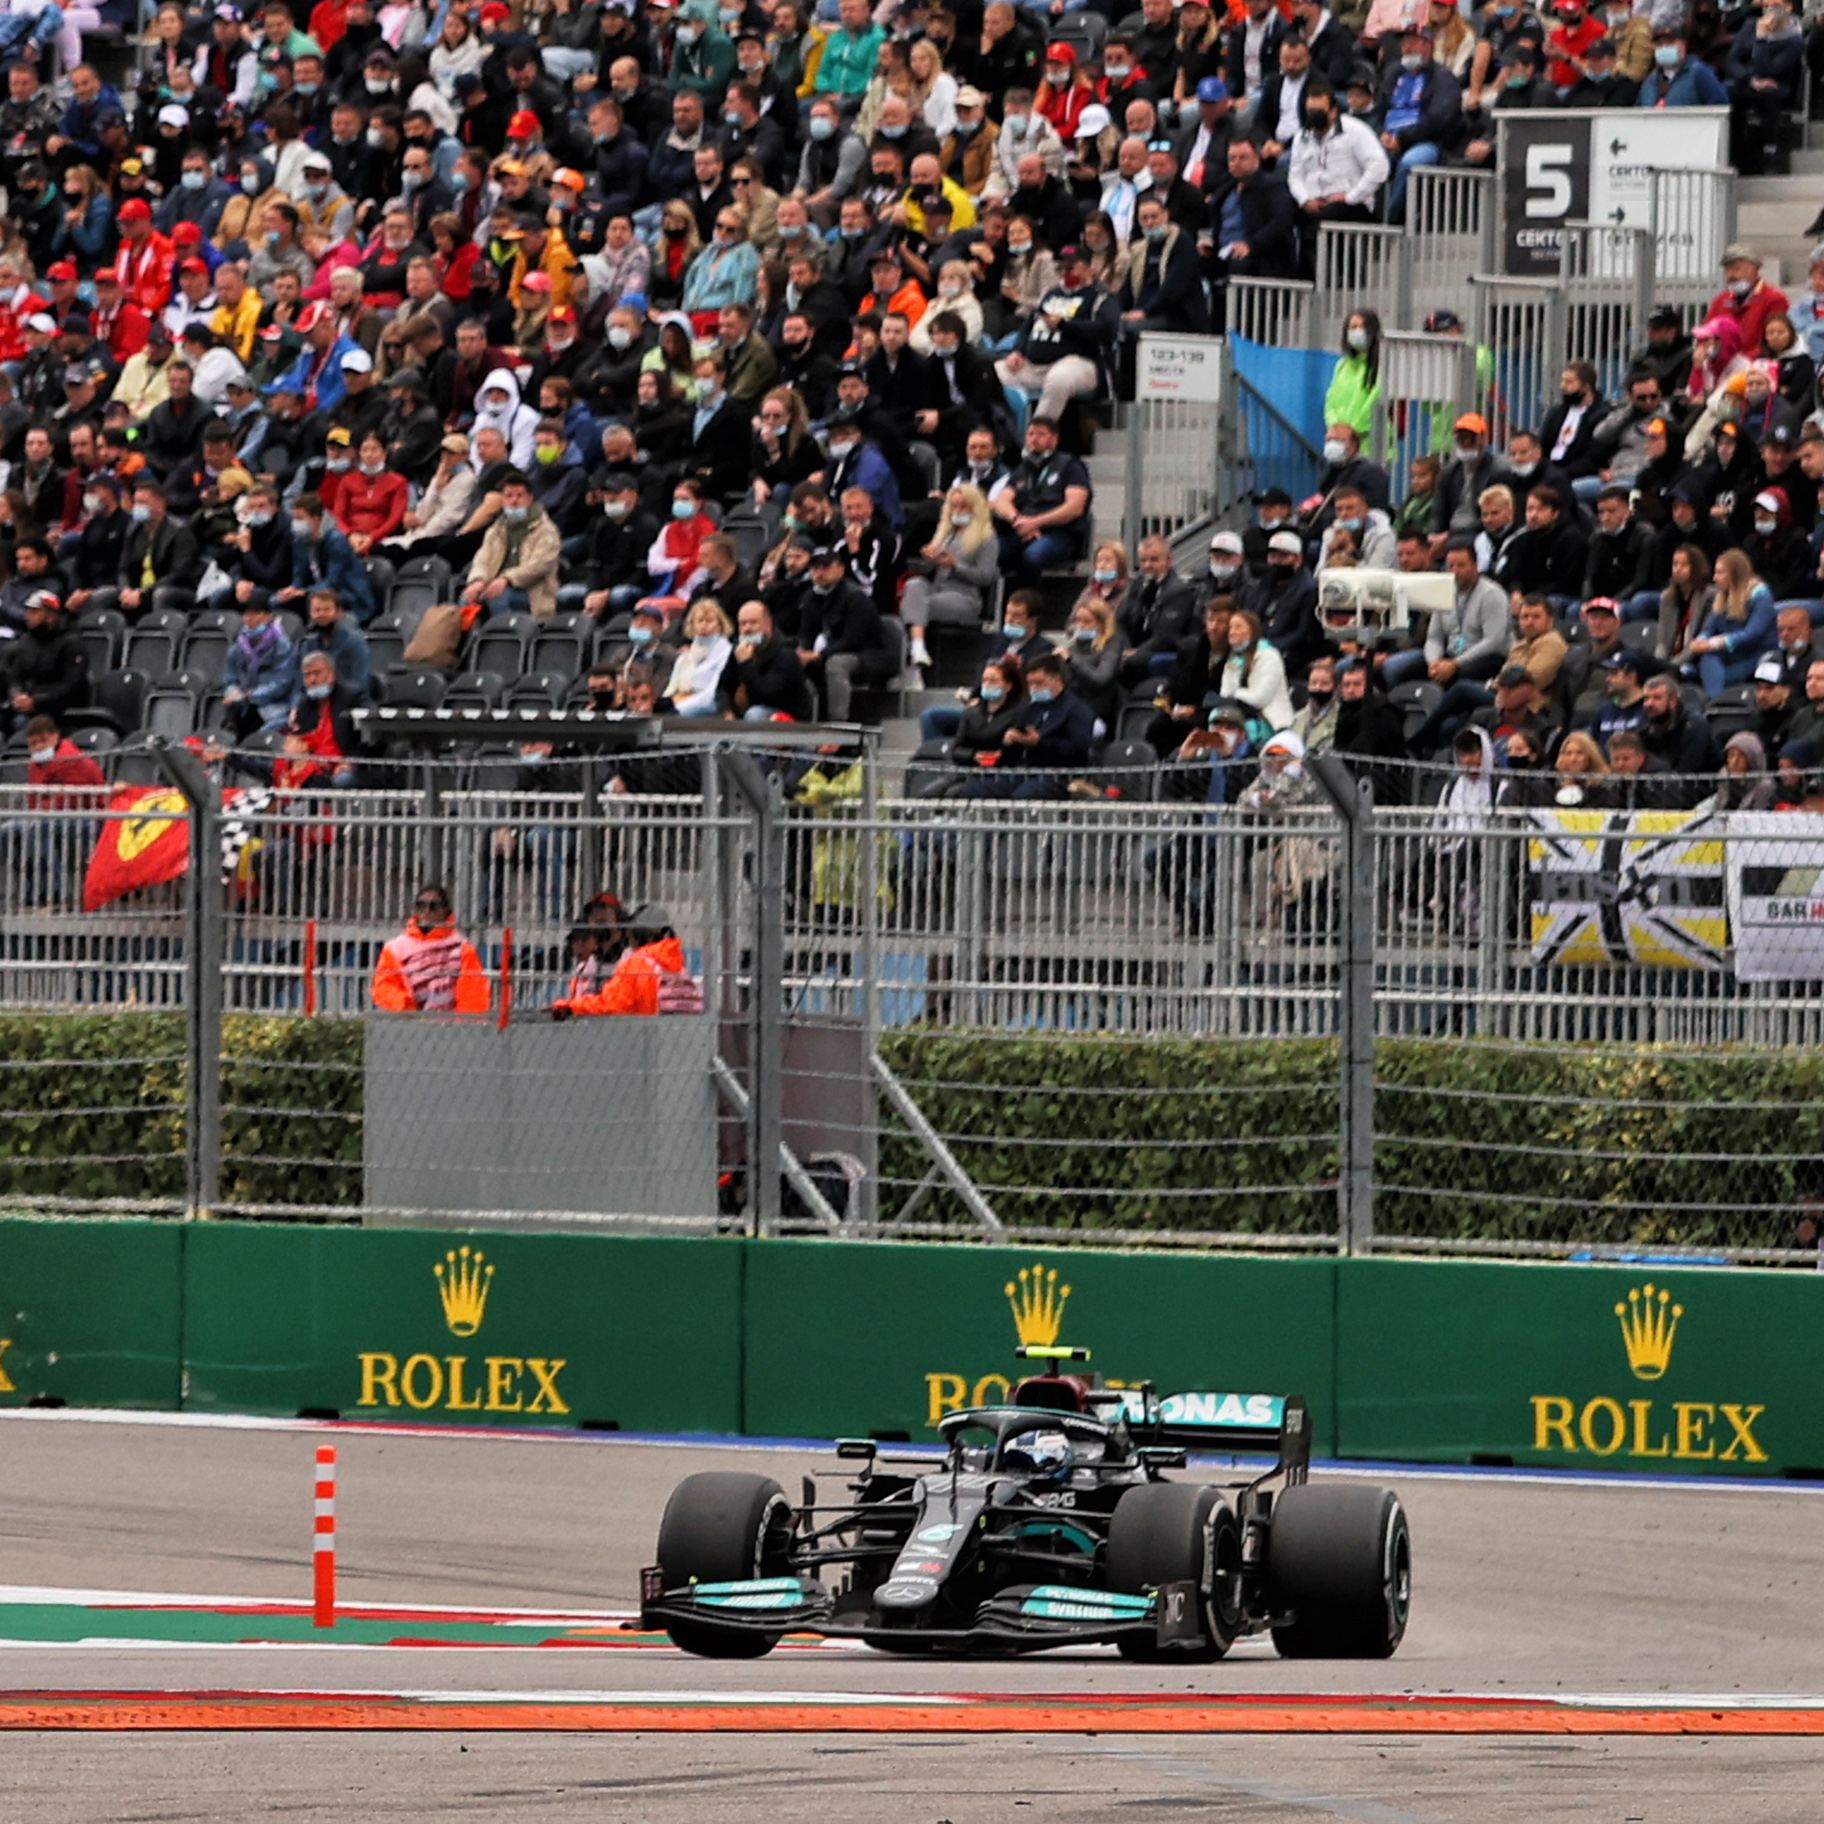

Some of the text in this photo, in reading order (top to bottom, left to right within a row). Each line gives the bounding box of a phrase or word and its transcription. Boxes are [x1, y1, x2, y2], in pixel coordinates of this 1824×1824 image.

[1525, 143, 1573, 218] 5
[357, 1352, 570, 1414] ROLEX
[1530, 1396, 1767, 1462] ROLEX
